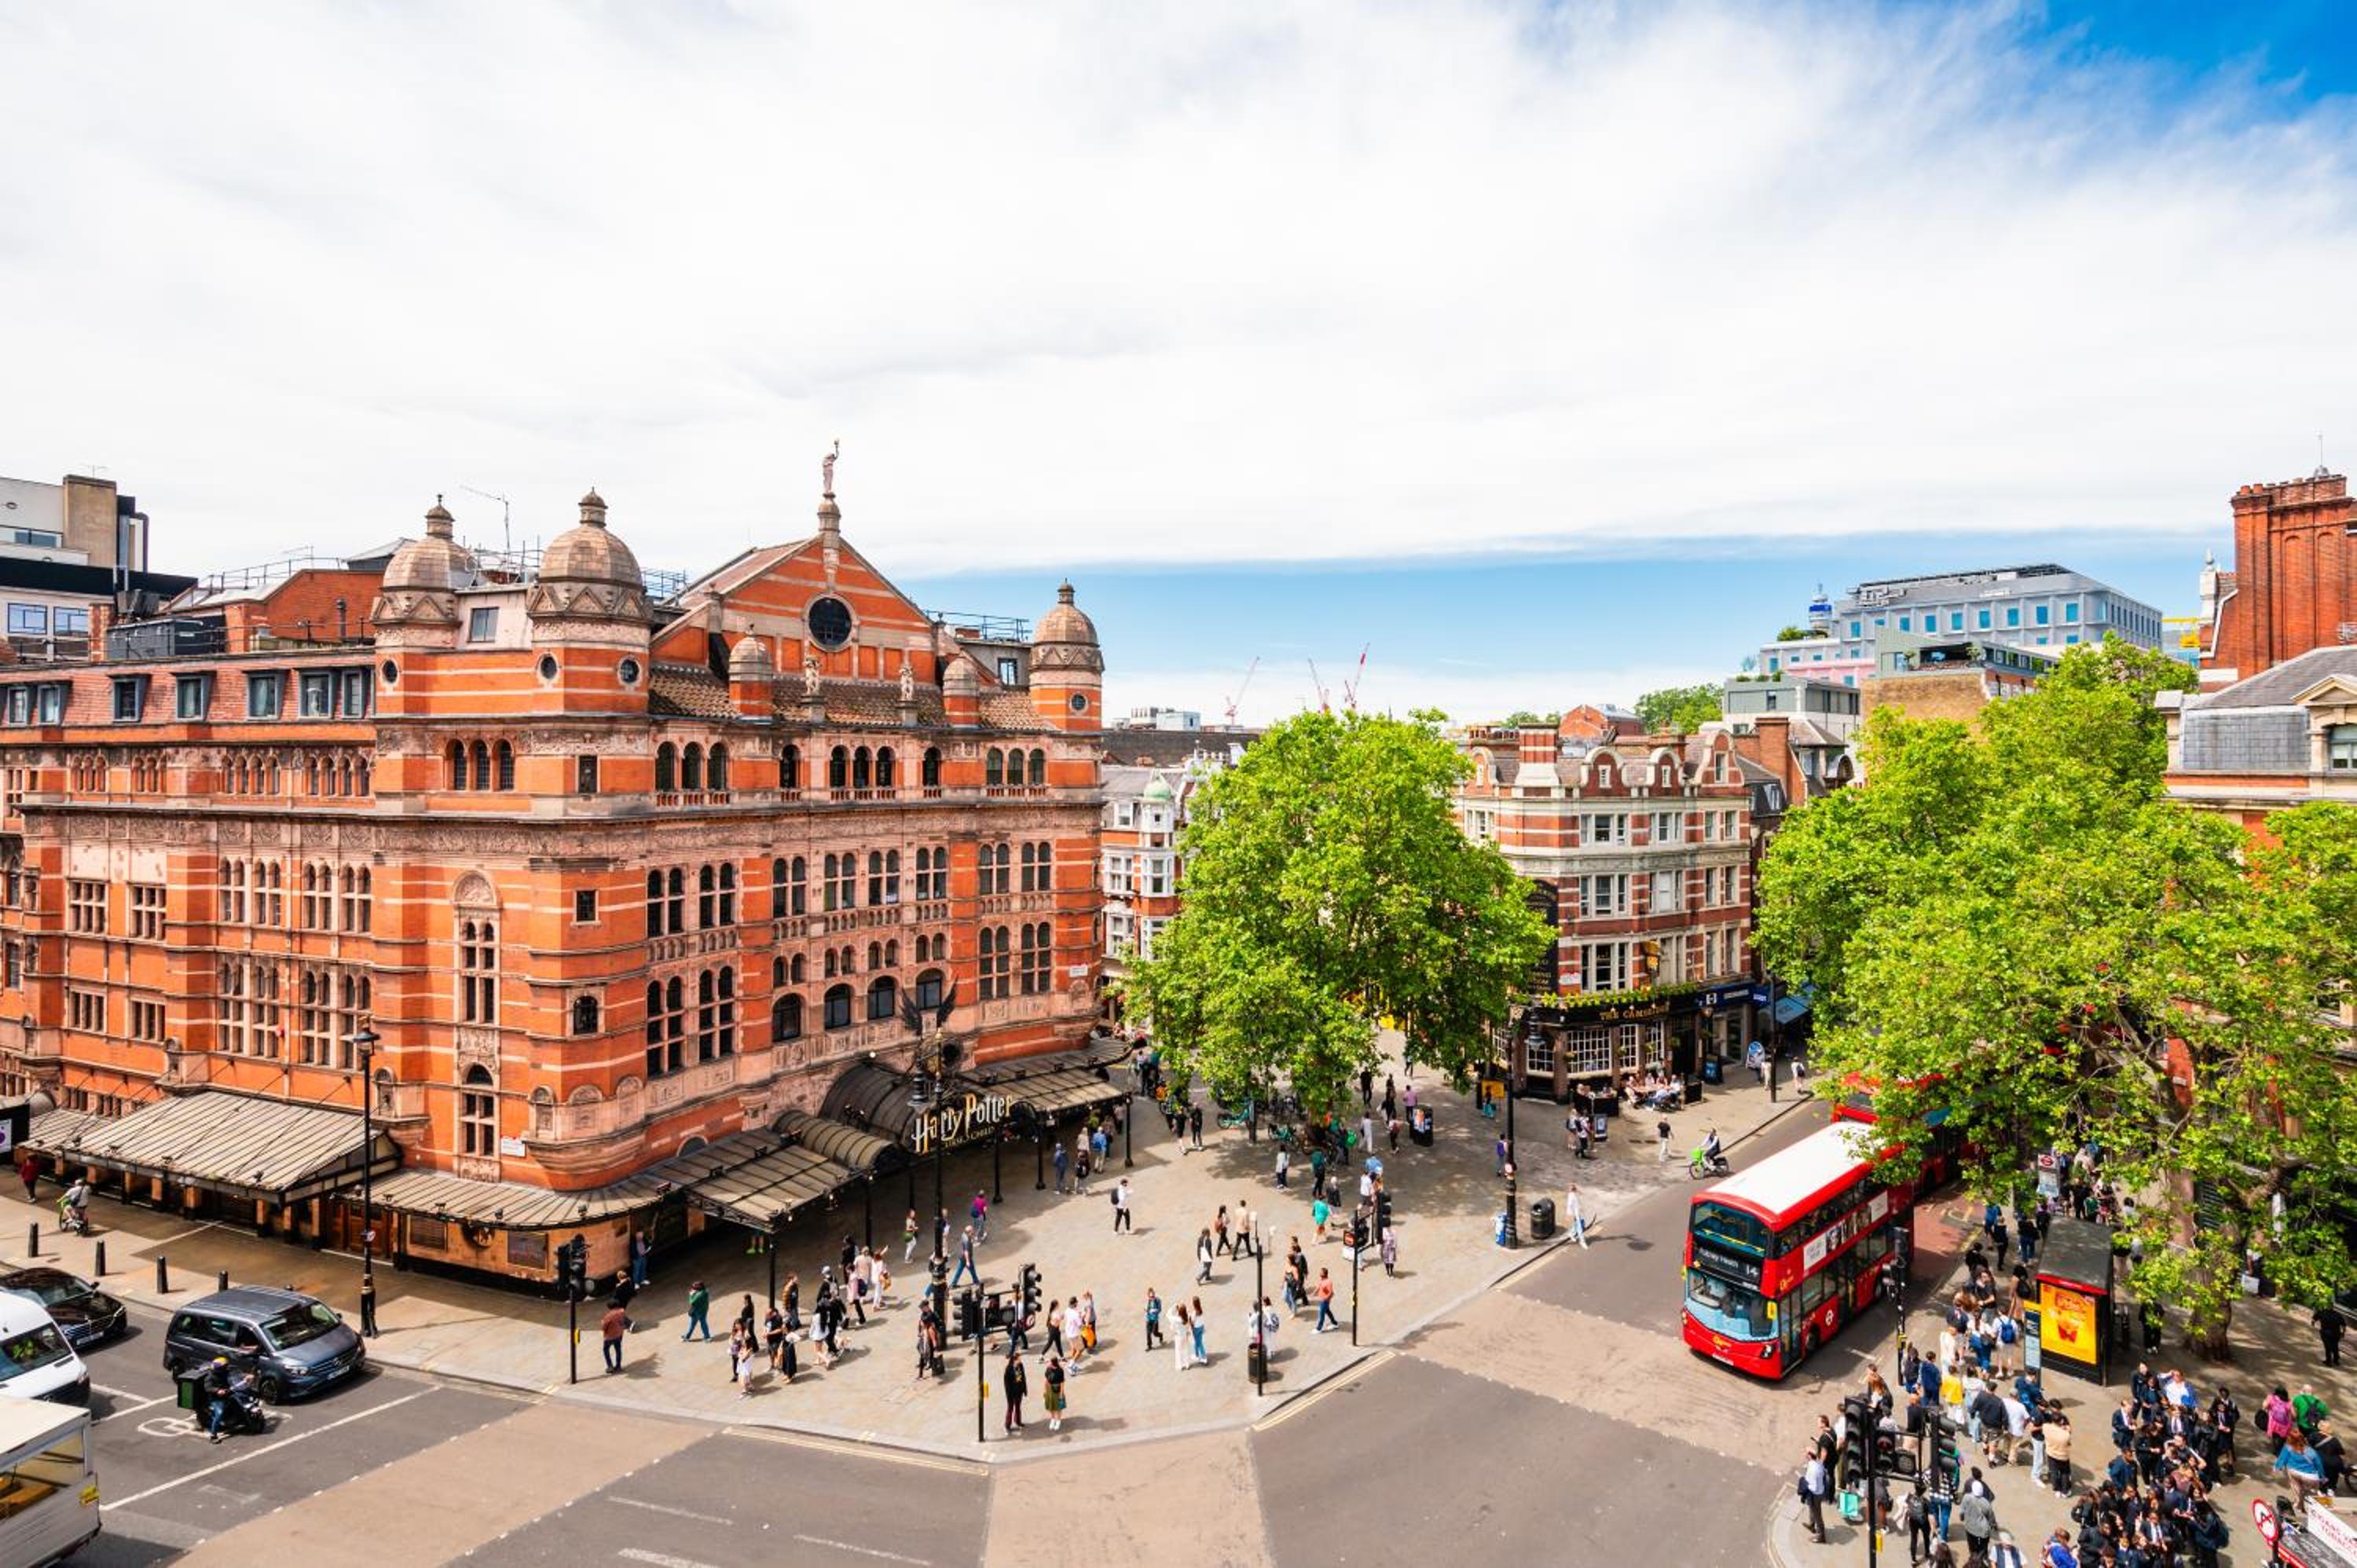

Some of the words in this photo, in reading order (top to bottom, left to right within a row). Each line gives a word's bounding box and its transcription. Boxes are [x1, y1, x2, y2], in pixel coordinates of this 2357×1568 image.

[911, 1107, 963, 1156] Harry
[963, 1093, 1014, 1139] Potter
[1747, 1264, 1758, 1278] 14
